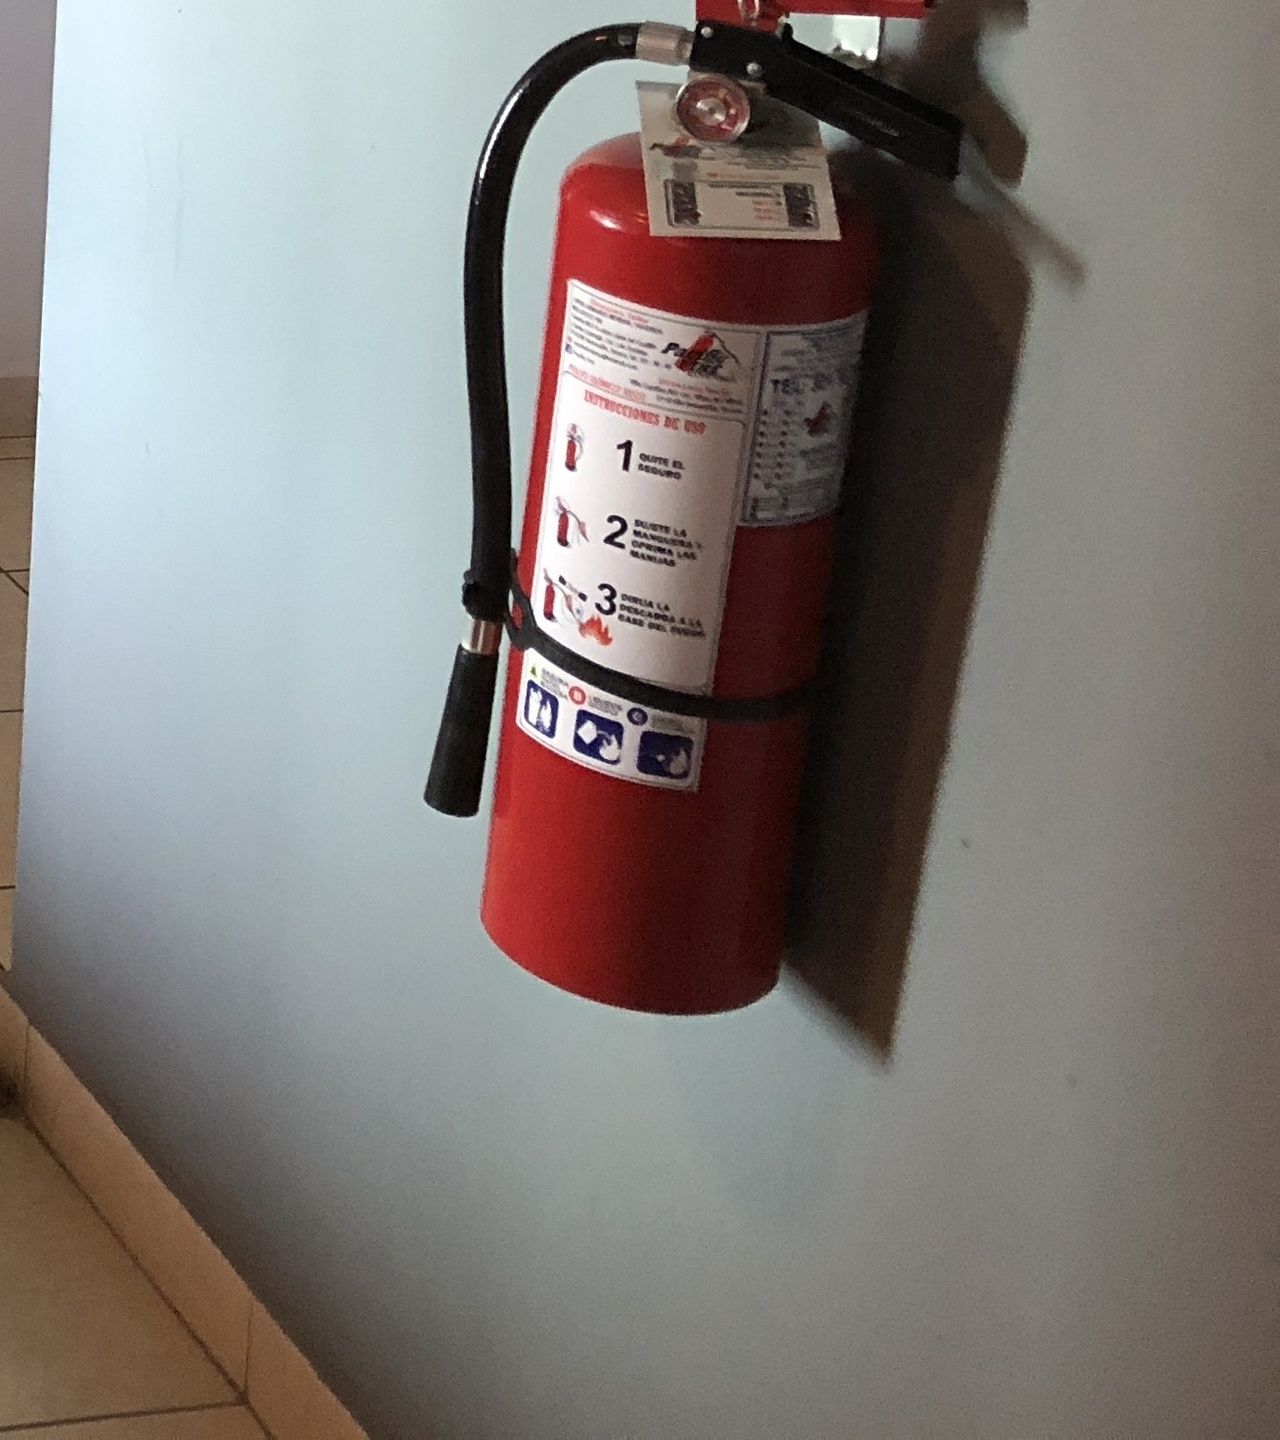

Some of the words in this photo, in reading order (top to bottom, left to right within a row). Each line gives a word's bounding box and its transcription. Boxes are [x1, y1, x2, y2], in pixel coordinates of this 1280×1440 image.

[616, 439, 634, 472] 1
[603, 514, 629, 550] 2
[594, 583, 618, 615] 3
